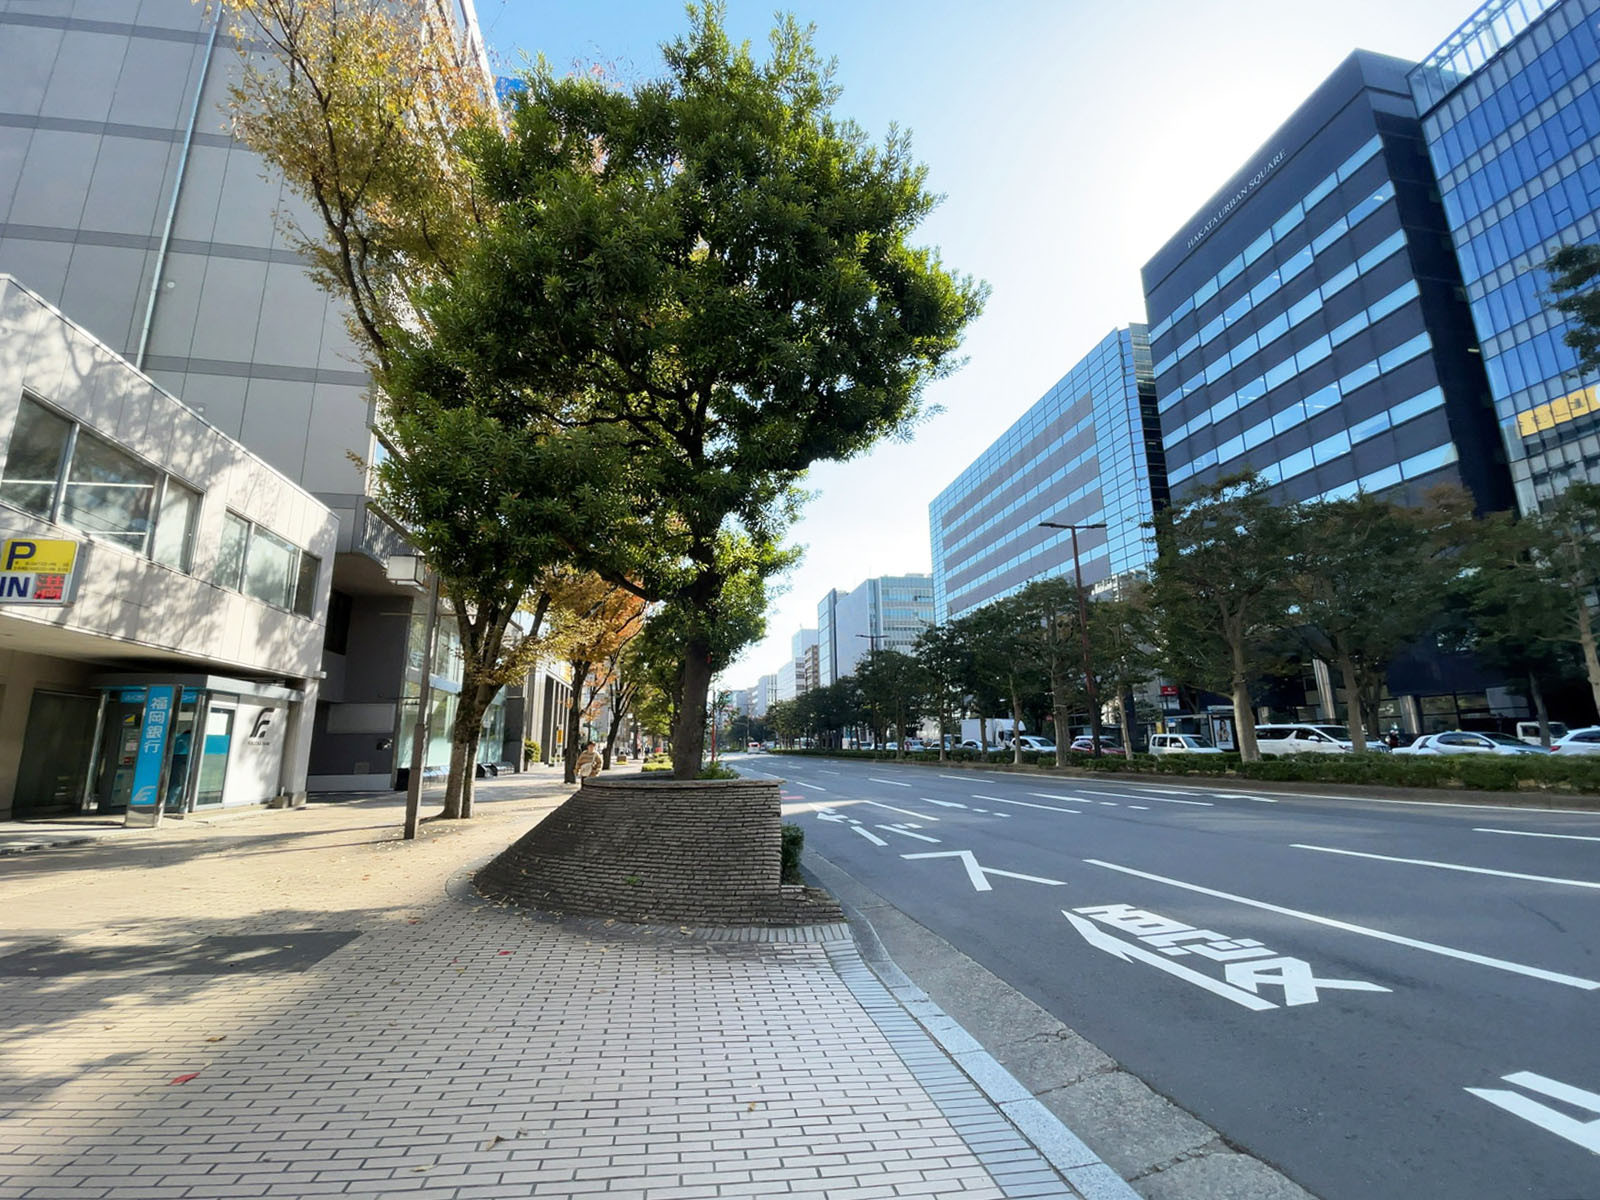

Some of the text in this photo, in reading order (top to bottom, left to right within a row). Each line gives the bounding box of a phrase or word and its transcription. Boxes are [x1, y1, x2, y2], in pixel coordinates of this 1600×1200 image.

[1186, 149, 1287, 249] HAKATA URBAN SQUARE
[6, 541, 37, 570] P
[144, 696, 169, 753] 福岡銀行
